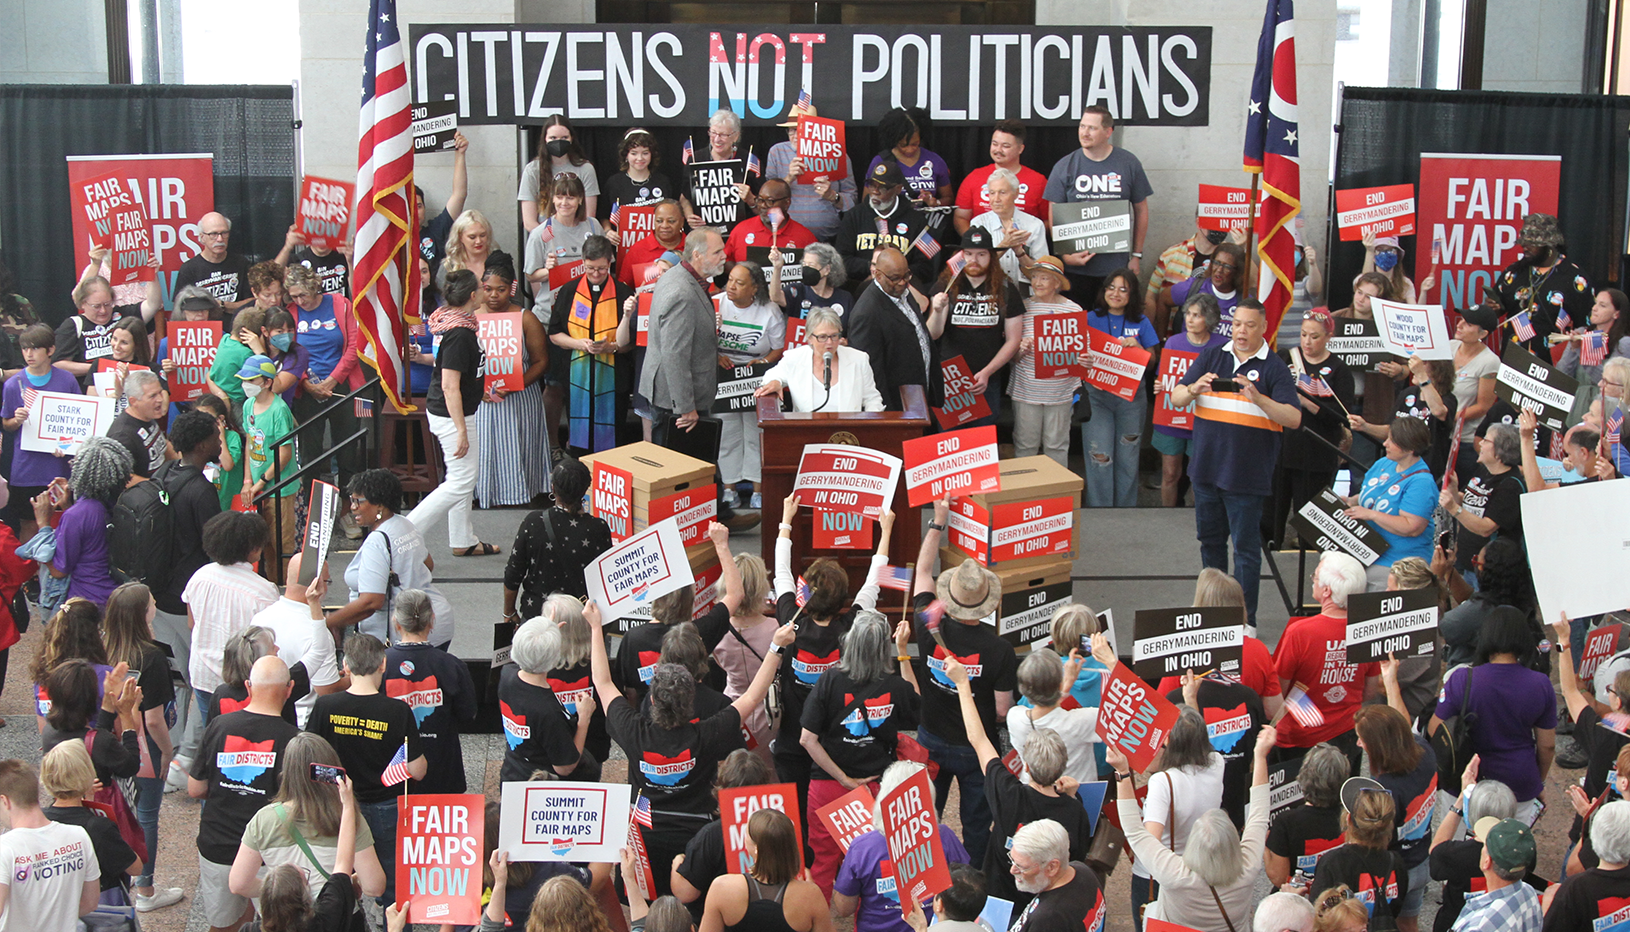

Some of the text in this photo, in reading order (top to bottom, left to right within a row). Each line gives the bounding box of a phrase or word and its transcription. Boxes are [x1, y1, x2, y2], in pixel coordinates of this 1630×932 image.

[416, 31, 1199, 120] CITIZENS NOT POLITICIANS
[804, 121, 836, 142] FAIR
[415, 135, 437, 149] OHIO
[800, 139, 842, 158] MAPS
[804, 156, 839, 172] NOW
[698, 168, 733, 187] FAIR
[1075, 173, 1122, 193] ONE
[84, 177, 122, 203] FAIR
[308, 181, 347, 203] FAIR
[695, 186, 741, 206] MAPS
[1227, 192, 1246, 203] END
[1366, 191, 1385, 206] END
[1446, 177, 1531, 220] FAIR
[116, 210, 143, 231] FAIR
[301, 200, 348, 224] MAPS
[701, 204, 737, 223] NOW
[1081, 205, 1100, 220] END
[1343, 202, 1409, 224] GERRYMANDERING
[302, 215, 342, 238] NOW
[1058, 218, 1124, 238] GERRYMANDERING
[1220, 219, 1229, 229] IN
[1372, 220, 1394, 235] OHIO
[115, 229, 149, 252] MAPS
[1075, 238, 1086, 251] IN
[1087, 234, 1109, 248] OHIO
[1432, 223, 1524, 266] MAP
[118, 249, 149, 269] NOW
[1042, 317, 1079, 337] FAIR
[1389, 321, 1427, 334] COUNTY FOR
[1395, 313, 1413, 323] WOOD
[177, 327, 213, 347] FAIR
[479, 319, 513, 338] FAIR
[1344, 323, 1364, 336] END
[1393, 331, 1425, 343] FAIR MAPS
[1038, 334, 1084, 353] MAPS
[1103, 340, 1123, 357] END
[1043, 350, 1080, 367] NOW
[1345, 354, 1369, 366] OHIO
[735, 364, 754, 378] END
[1096, 370, 1119, 386] OHIO
[1528, 362, 1549, 381] END
[1503, 369, 1567, 406] GERRYMANDERING
[57, 404, 81, 415] STARK
[730, 397, 740, 409] IN
[1511, 391, 1545, 416] IN OHIO
[45, 414, 91, 427] COUNTY FOR
[48, 424, 87, 436] FAIR MAPS
[937, 436, 960, 456] END
[832, 457, 857, 471] END
[912, 449, 991, 483] GERRYMANDERING
[598, 469, 625, 497] FAIR
[799, 475, 883, 490] GERRYMANDERING
[931, 472, 972, 497] IN OHIO
[595, 488, 629, 518] MAPS
[673, 495, 690, 513] END
[814, 491, 858, 506] IN OHIO
[962, 502, 974, 517] END
[1023, 505, 1042, 521] END
[822, 511, 863, 532] NOW
[950, 515, 986, 538] GERRYMANDERING
[997, 516, 1067, 543] GERRYMANDERING
[309, 521, 320, 549] END
[958, 532, 976, 552] IN OHIO
[1306, 508, 1371, 560] GERRYMANDERING
[1353, 527, 1369, 539] IN
[1014, 536, 1049, 555] IN OHIO
[615, 545, 645, 568] SUMMIT
[607, 552, 660, 584] COUNTY FOR
[614, 577, 635, 593] FAIR
[636, 565, 659, 583] MAPS
[1028, 591, 1046, 608] END
[1380, 596, 1403, 614] END
[620, 620, 629, 632] IN
[1175, 612, 1202, 631] END
[1352, 612, 1431, 640] GERRYMANDERING
[1020, 629, 1029, 643] IN
[1142, 629, 1235, 655] GERRYMANDERING
[1371, 642, 1382, 657] IN
[1384, 634, 1410, 654] OHIO
[1586, 633, 1613, 657] FAIR
[793, 660, 806, 672] FAIR
[928, 656, 943, 670] FAIR
[1165, 656, 1179, 673] IN
[1180, 650, 1212, 669] OHIO
[1320, 667, 1358, 684] HOUSE
[1100, 677, 1128, 729] FAIR
[329, 714, 359, 727] POVERTY
[366, 719, 389, 732] DEATH
[1106, 682, 1146, 745] MAPS
[334, 725, 383, 740] AMERICA'S SHAME
[1118, 699, 1159, 754] NOW
[1215, 713, 1251, 735] DISTRICTS
[218, 752, 274, 766] FAIR DISTRICTS
[641, 760, 695, 775] FAIR DISTRICTS
[1269, 769, 1285, 788] END
[545, 797, 586, 808] SUMMIT
[889, 785, 923, 832] FAIR
[412, 805, 468, 834] FAIR
[531, 810, 598, 822] COUNTY FOR
[828, 799, 872, 835] FAIR
[535, 824, 592, 836] FAIR MAPS
[889, 810, 933, 863] MAPS
[1399, 818, 1416, 837] FAIR
[15, 841, 83, 865] ASK ME ABOUT
[32, 849, 84, 870] RANKED CHOICE
[403, 836, 477, 866] MAPS
[33, 858, 84, 882] VOTING
[641, 855, 650, 870] IN
[897, 841, 934, 889] NOW
[1298, 855, 1316, 867] FAIR
[409, 867, 469, 896] NOW
[877, 877, 895, 894] FAIR
[1595, 916, 1613, 932] FAIR
